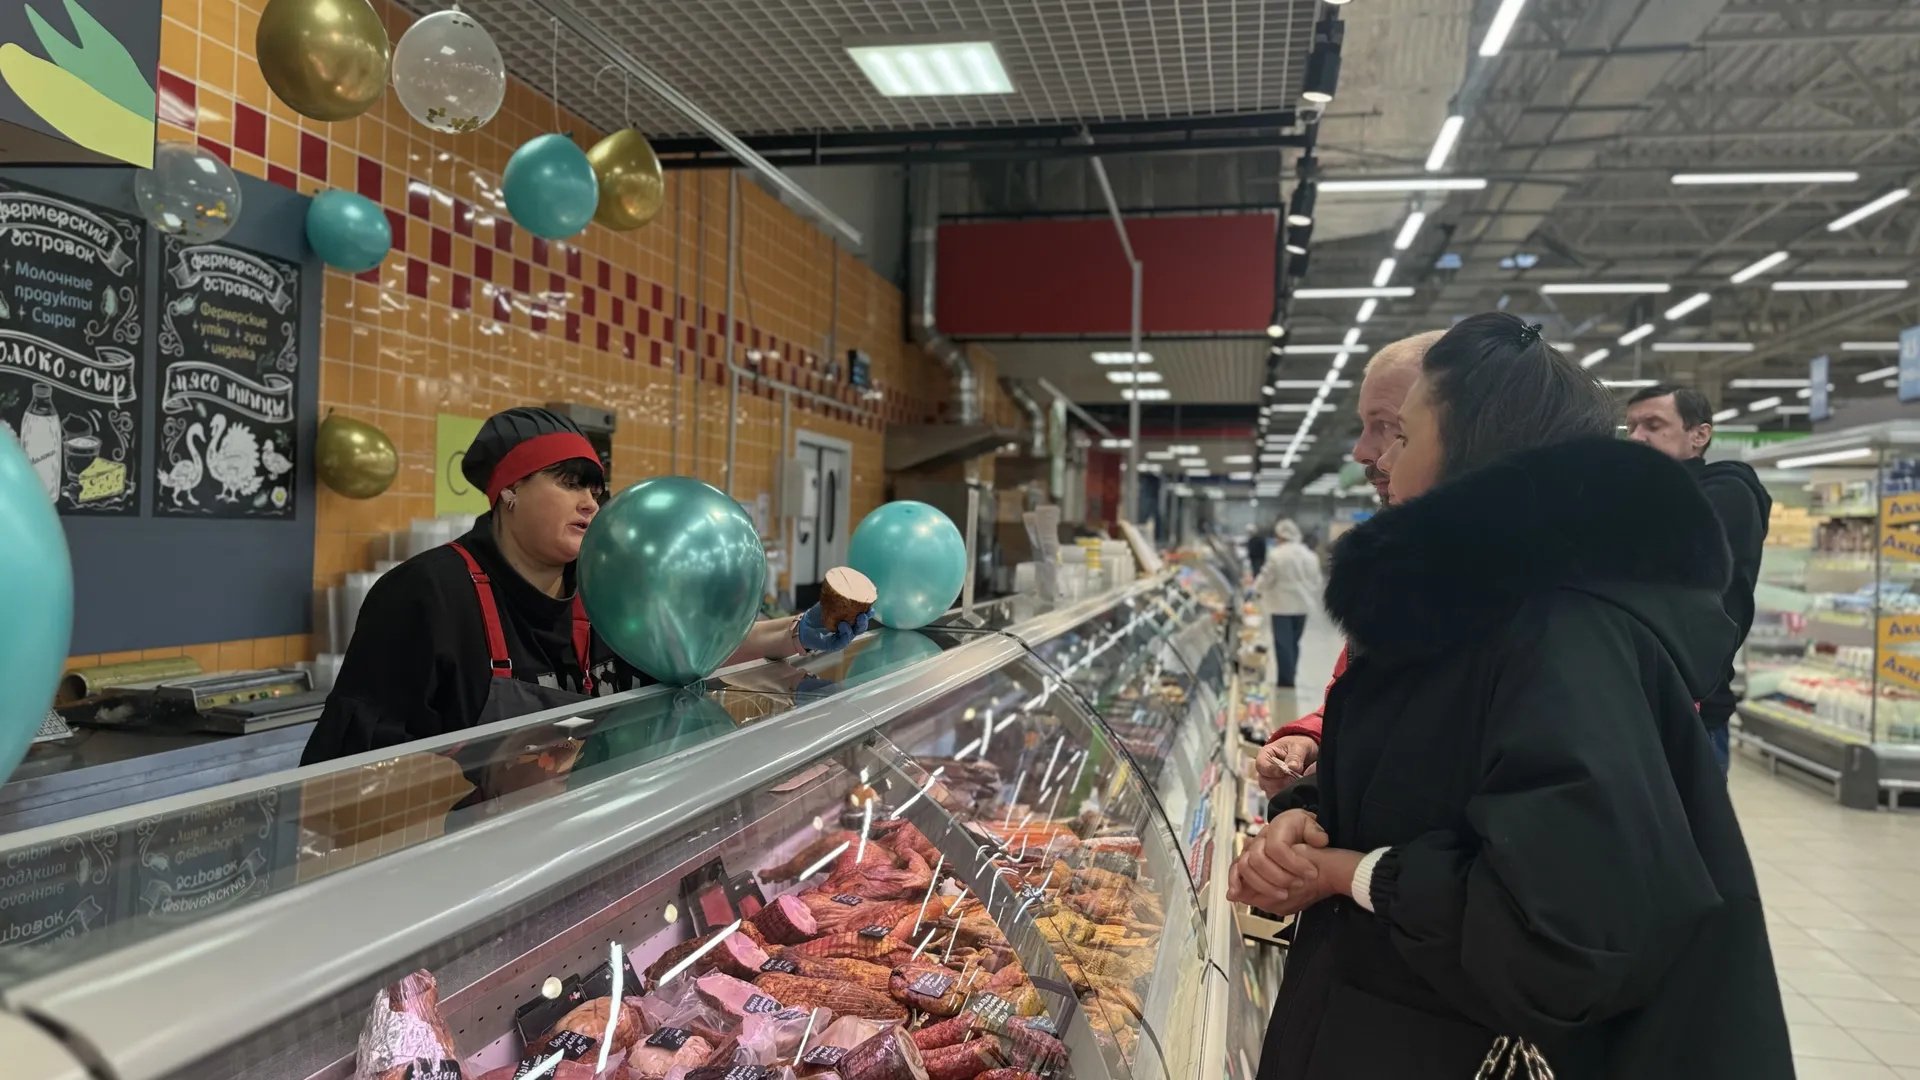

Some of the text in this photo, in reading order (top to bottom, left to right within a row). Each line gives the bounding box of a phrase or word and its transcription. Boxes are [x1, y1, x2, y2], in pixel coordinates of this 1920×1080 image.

[15, 260, 93, 291] Молочные
[14, 284, 93, 311] продукты
[32, 306, 76, 329] Сыры
[200, 302, 268, 329] Фермерские
[200, 322, 267, 346] утки гуси
[211, 343, 256, 361] индейка
